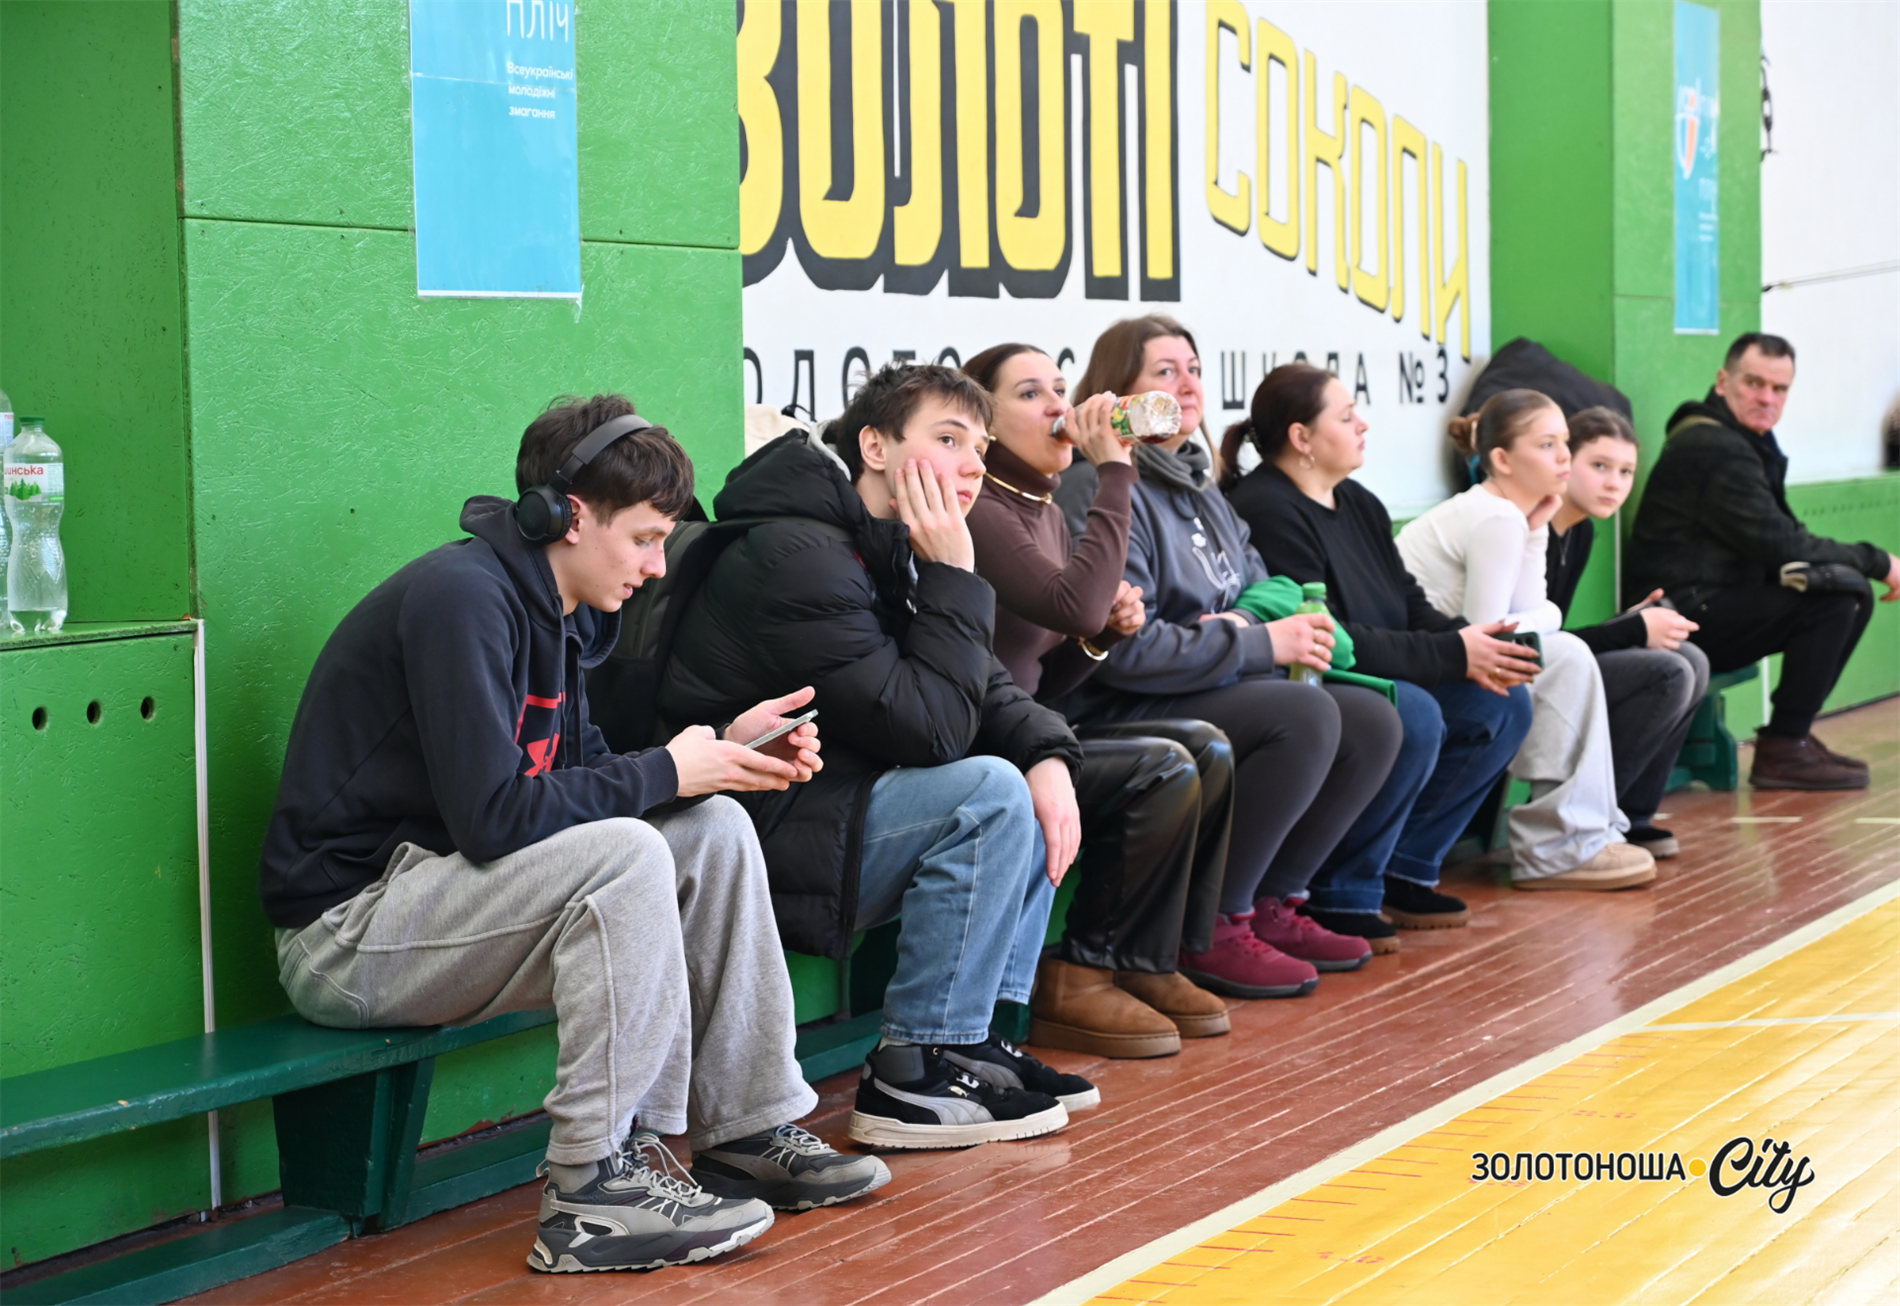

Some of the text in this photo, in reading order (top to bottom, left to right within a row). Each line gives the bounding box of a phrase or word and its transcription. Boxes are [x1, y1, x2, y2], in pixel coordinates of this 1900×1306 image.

[507, 61, 574, 80] Всеукраїнські
[508, 84, 556, 99] молодіжні
[508, 106, 556, 119] змагання
[1205, 0, 1470, 363] СОКОЛИ
